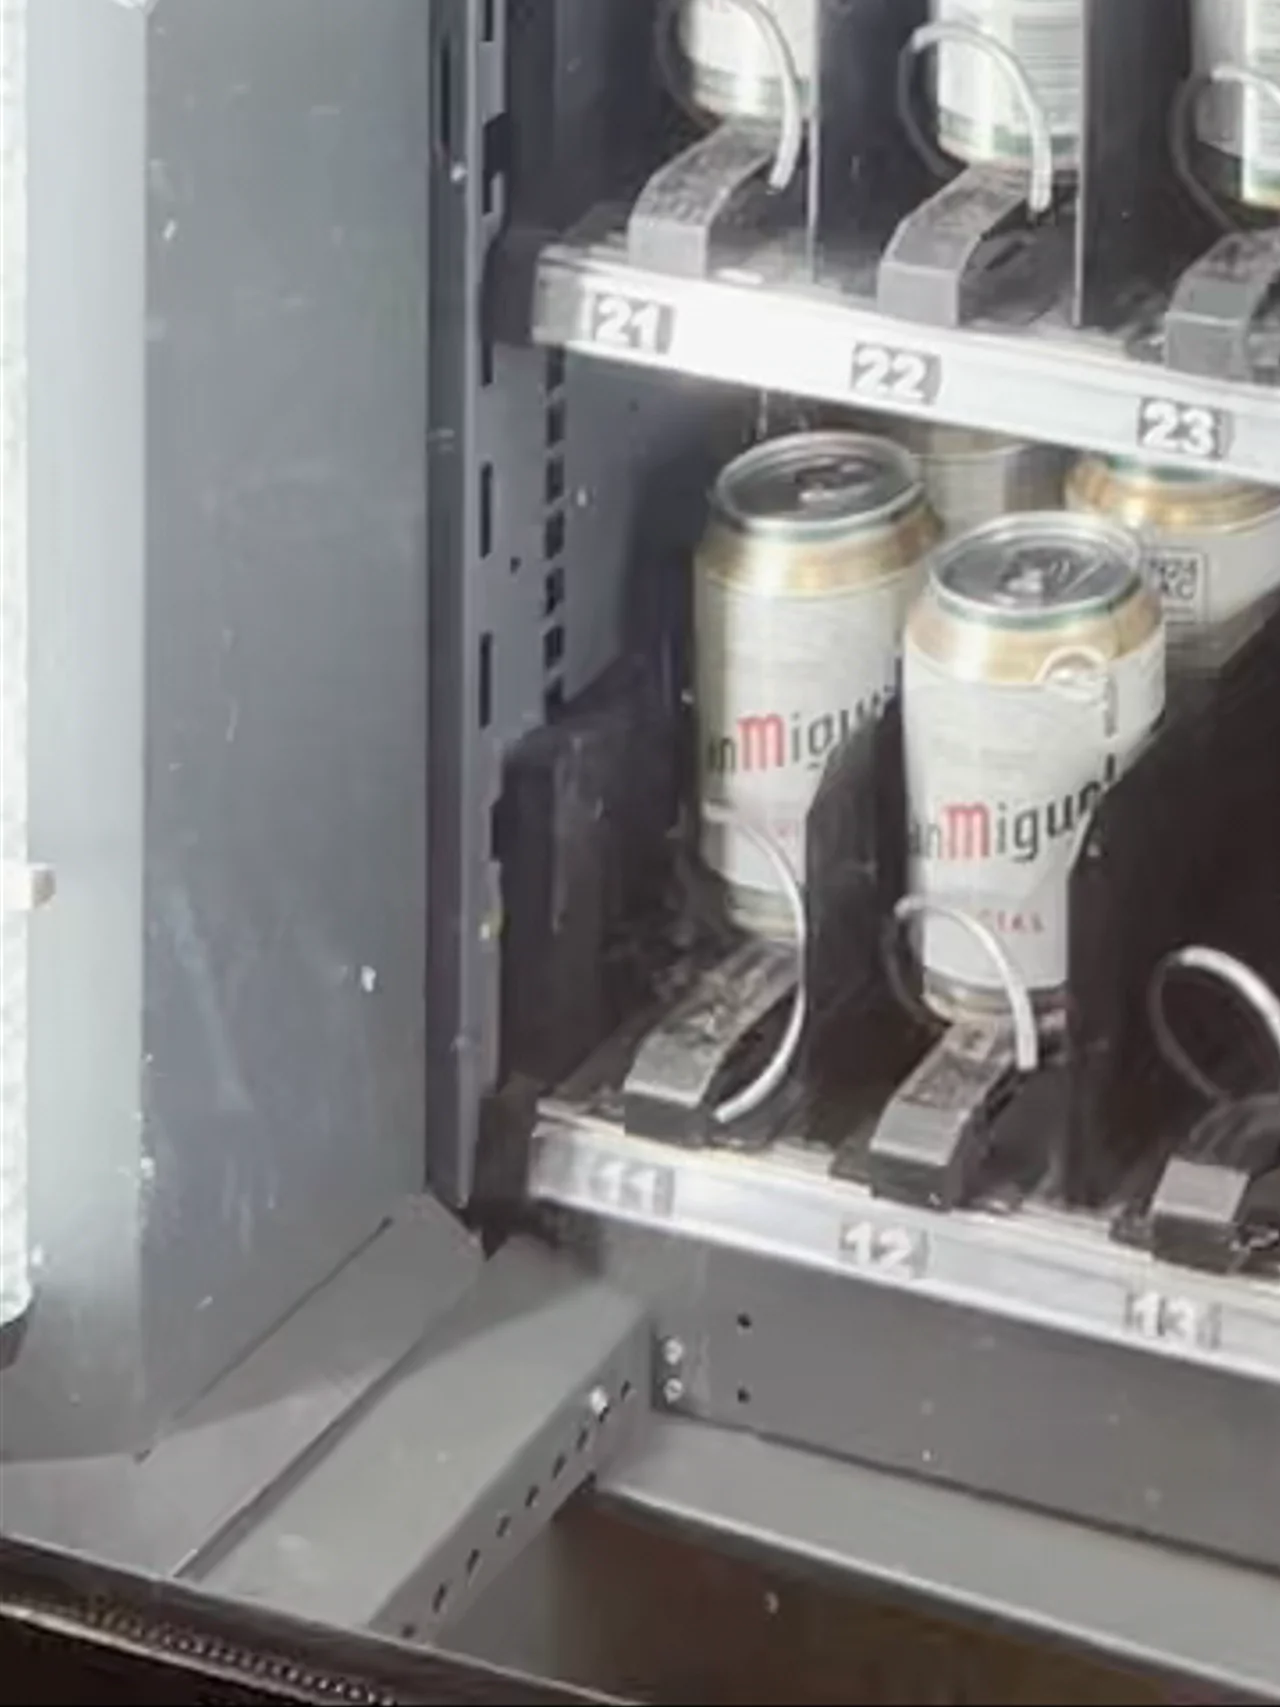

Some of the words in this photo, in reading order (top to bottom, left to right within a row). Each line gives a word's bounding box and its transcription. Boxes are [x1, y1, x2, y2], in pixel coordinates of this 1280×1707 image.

[595, 299, 664, 348] 21
[851, 345, 931, 402] 22
[1140, 402, 1219, 453] 23
[843, 1223, 917, 1274] 12
[1130, 1293, 1200, 1345] 13
